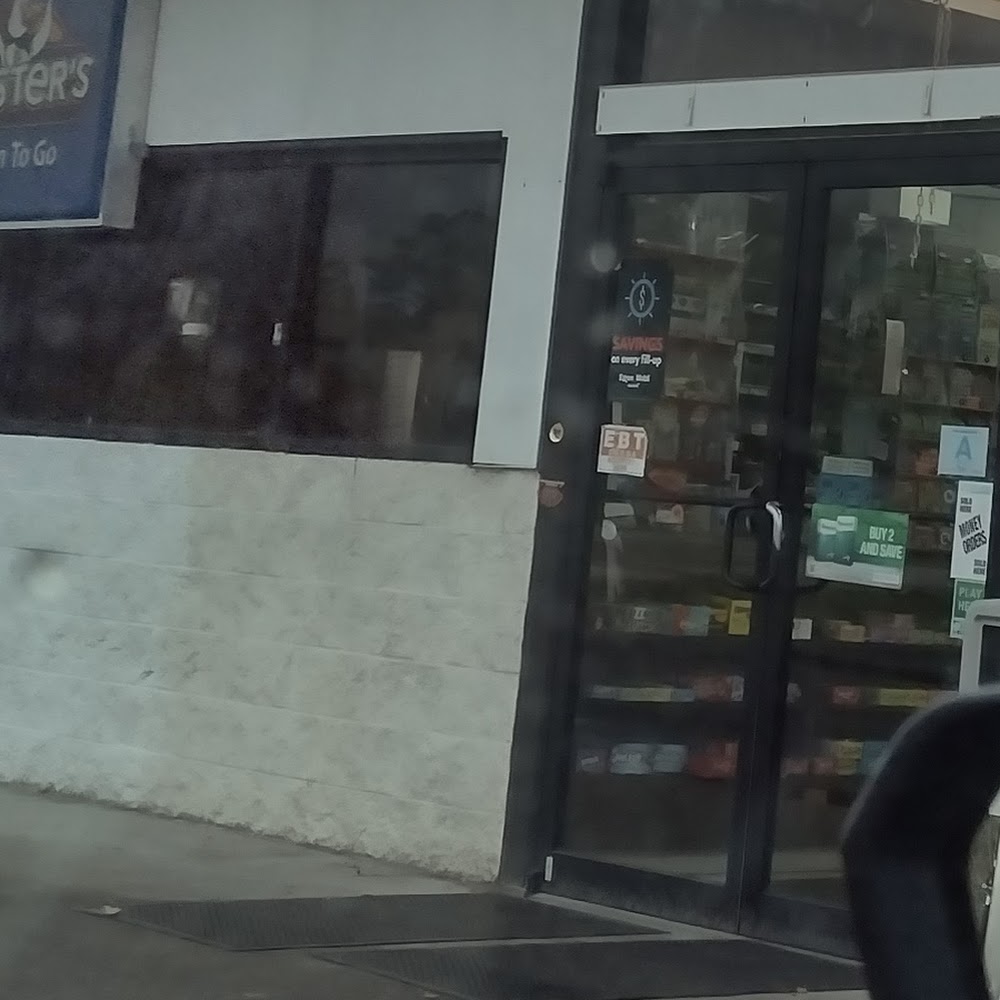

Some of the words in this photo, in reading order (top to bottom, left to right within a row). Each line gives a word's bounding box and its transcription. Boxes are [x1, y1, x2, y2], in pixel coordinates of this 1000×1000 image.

[612, 335, 664, 352] SAVINGS
[603, 429, 646, 450] EBT
[869, 526, 888, 541] BUY
[888, 528, 895, 542] 2
[959, 513, 982, 538] MONEY
[860, 541, 879, 556] AND
[879, 543, 904, 559] SAVE
[962, 530, 988, 554] ORDERS
